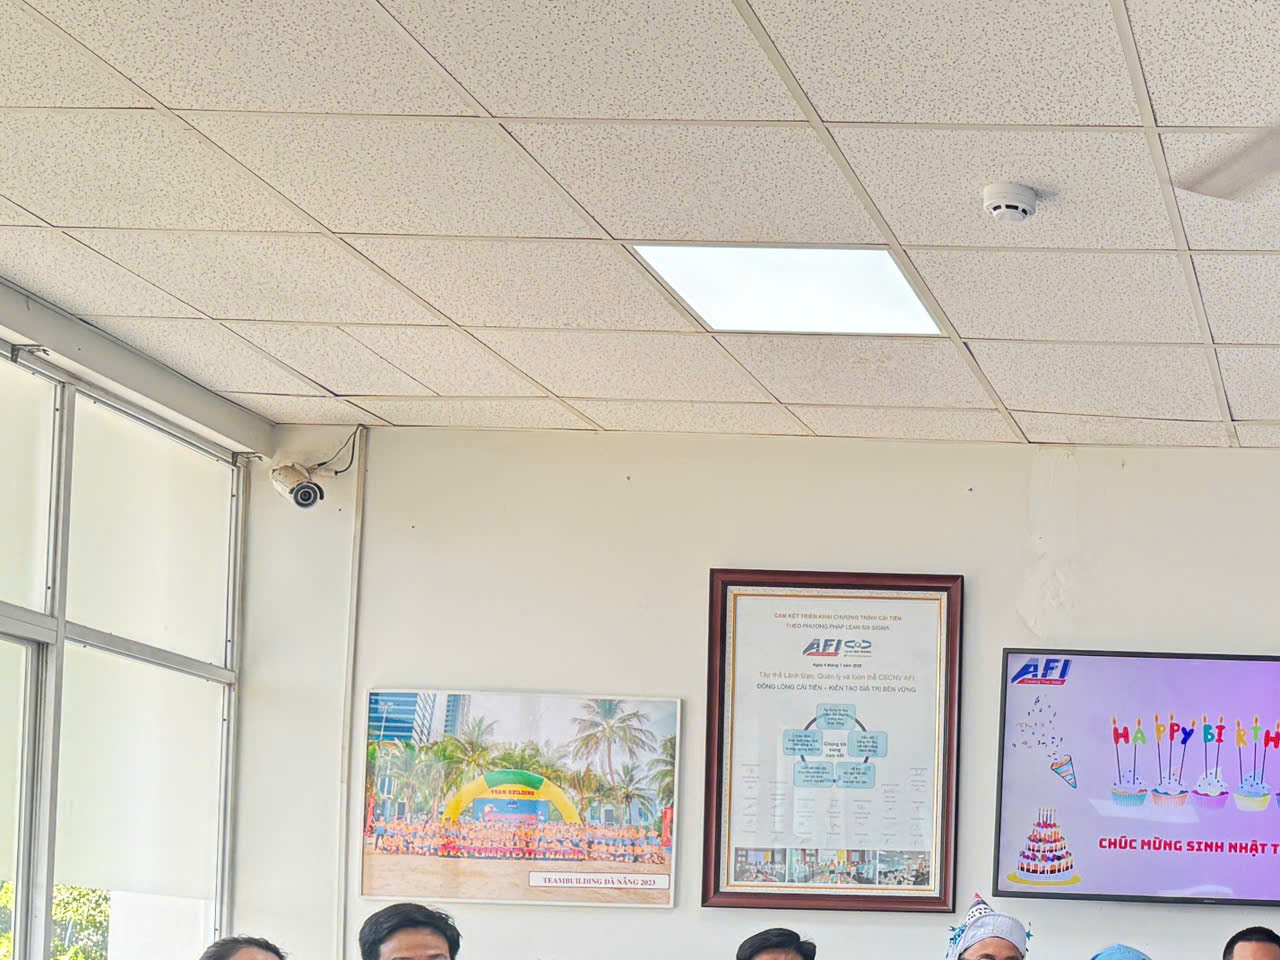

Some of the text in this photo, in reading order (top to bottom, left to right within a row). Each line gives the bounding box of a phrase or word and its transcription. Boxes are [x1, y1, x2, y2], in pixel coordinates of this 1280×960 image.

[802, 638, 842, 655] AFI
[1010, 657, 1072, 684] AFI
[1113, 722, 1194, 744] HAPPY
[1141, 836, 1183, 852] MỪNG
[1186, 841, 1224, 853] SINH
[1228, 840, 1268, 858] NHẬT
